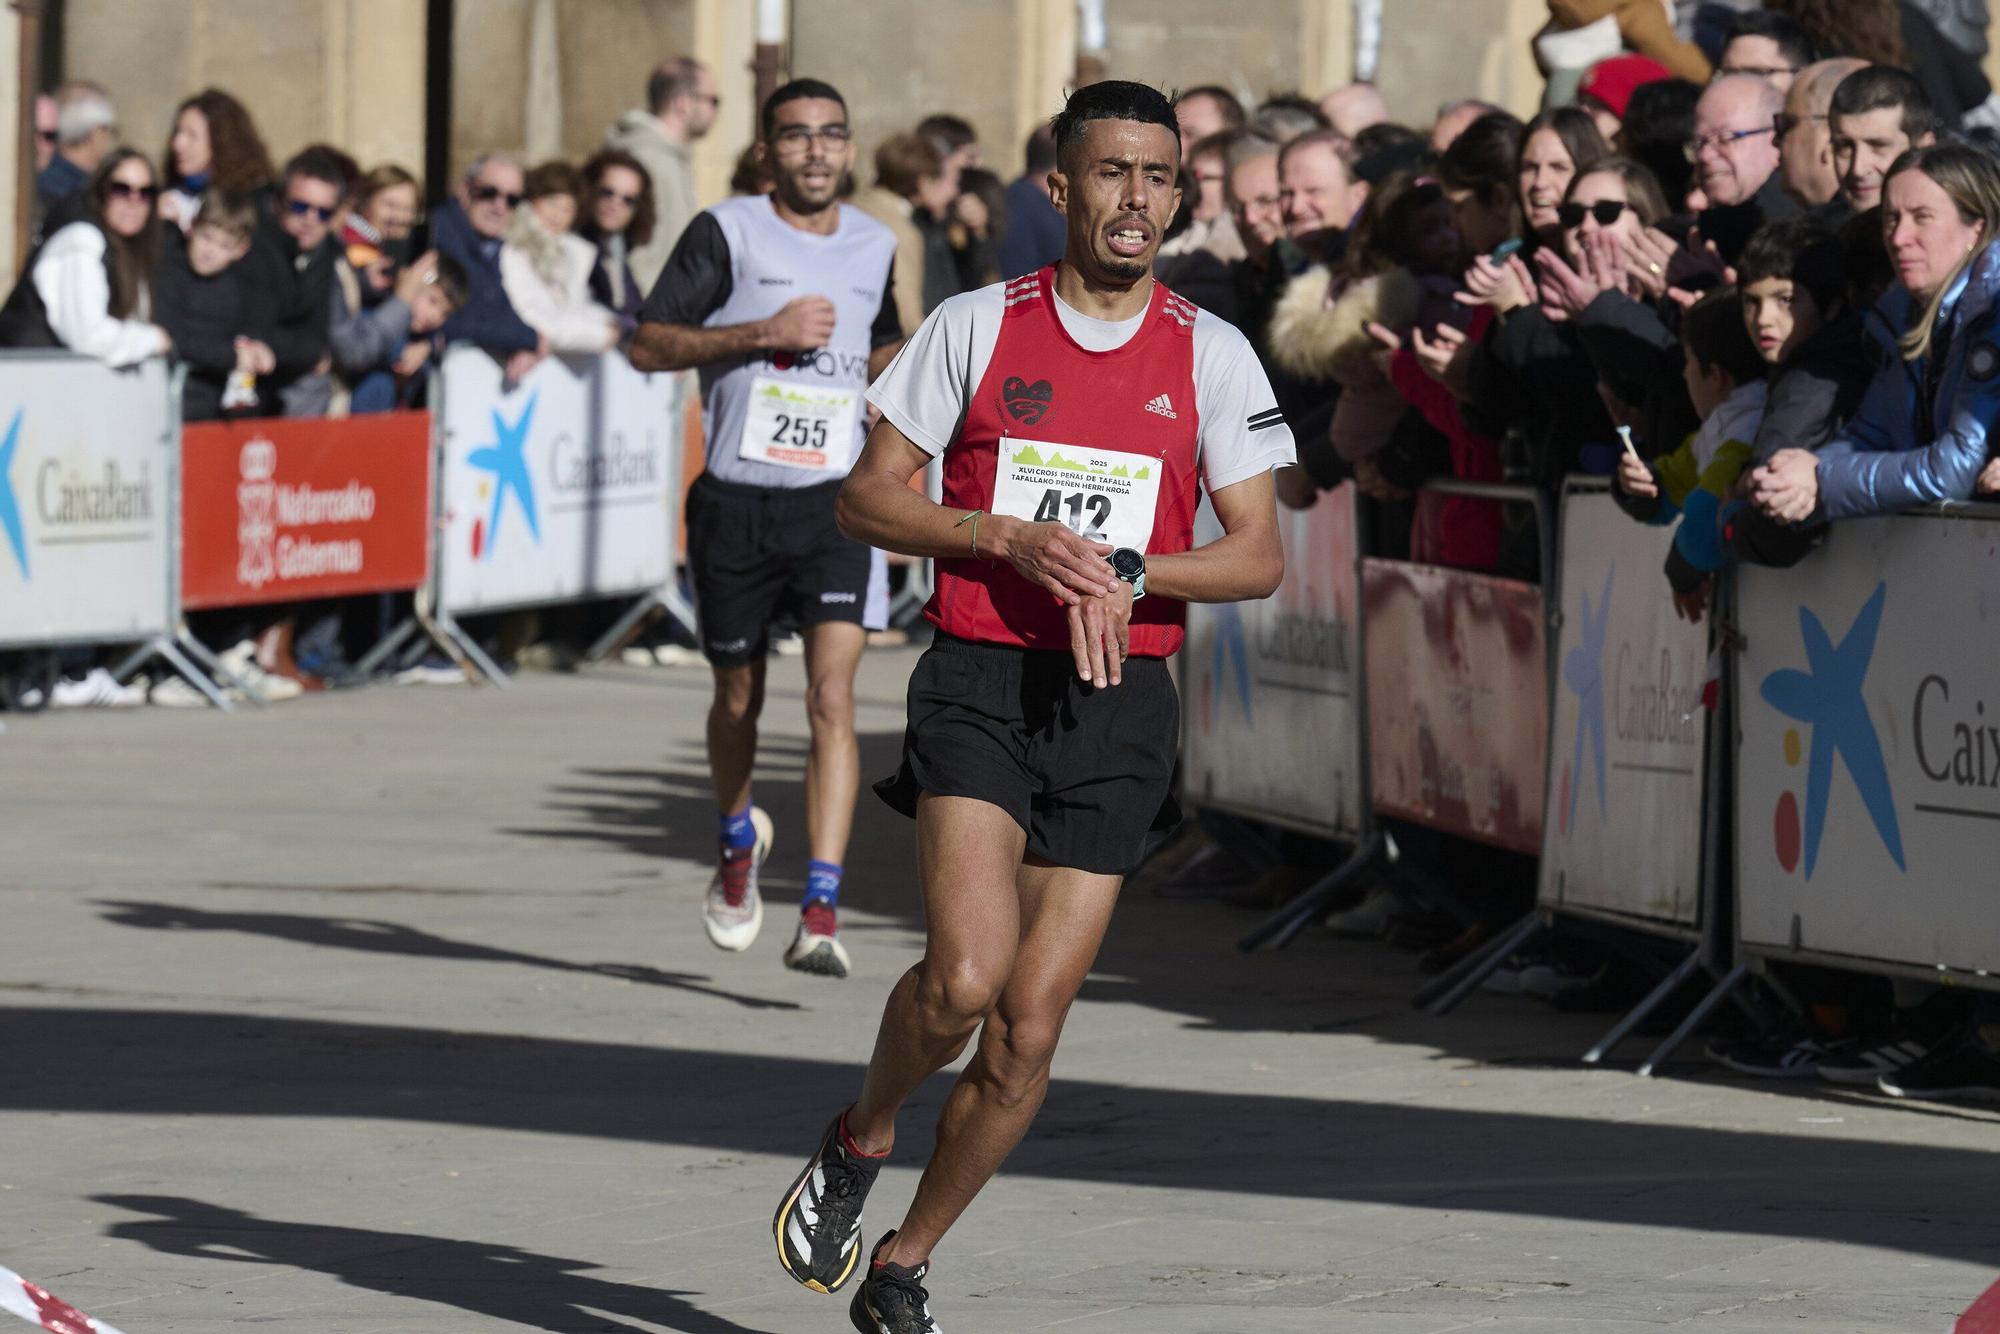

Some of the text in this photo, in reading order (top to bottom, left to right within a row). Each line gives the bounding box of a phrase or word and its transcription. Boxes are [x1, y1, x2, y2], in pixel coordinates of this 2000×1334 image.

[1144, 403, 1177, 420] adidas
[772, 414, 828, 448] 255
[1090, 459, 1108, 467] 2025
[1011, 474, 1130, 495] TAFALLAKO PEÑEN HERRI KROSA
[1018, 466, 1132, 487] XLVI CROSS PEÑAS DE TAFALLA
[36, 456, 155, 526] CaixaBank
[1033, 488, 1112, 541] 412
